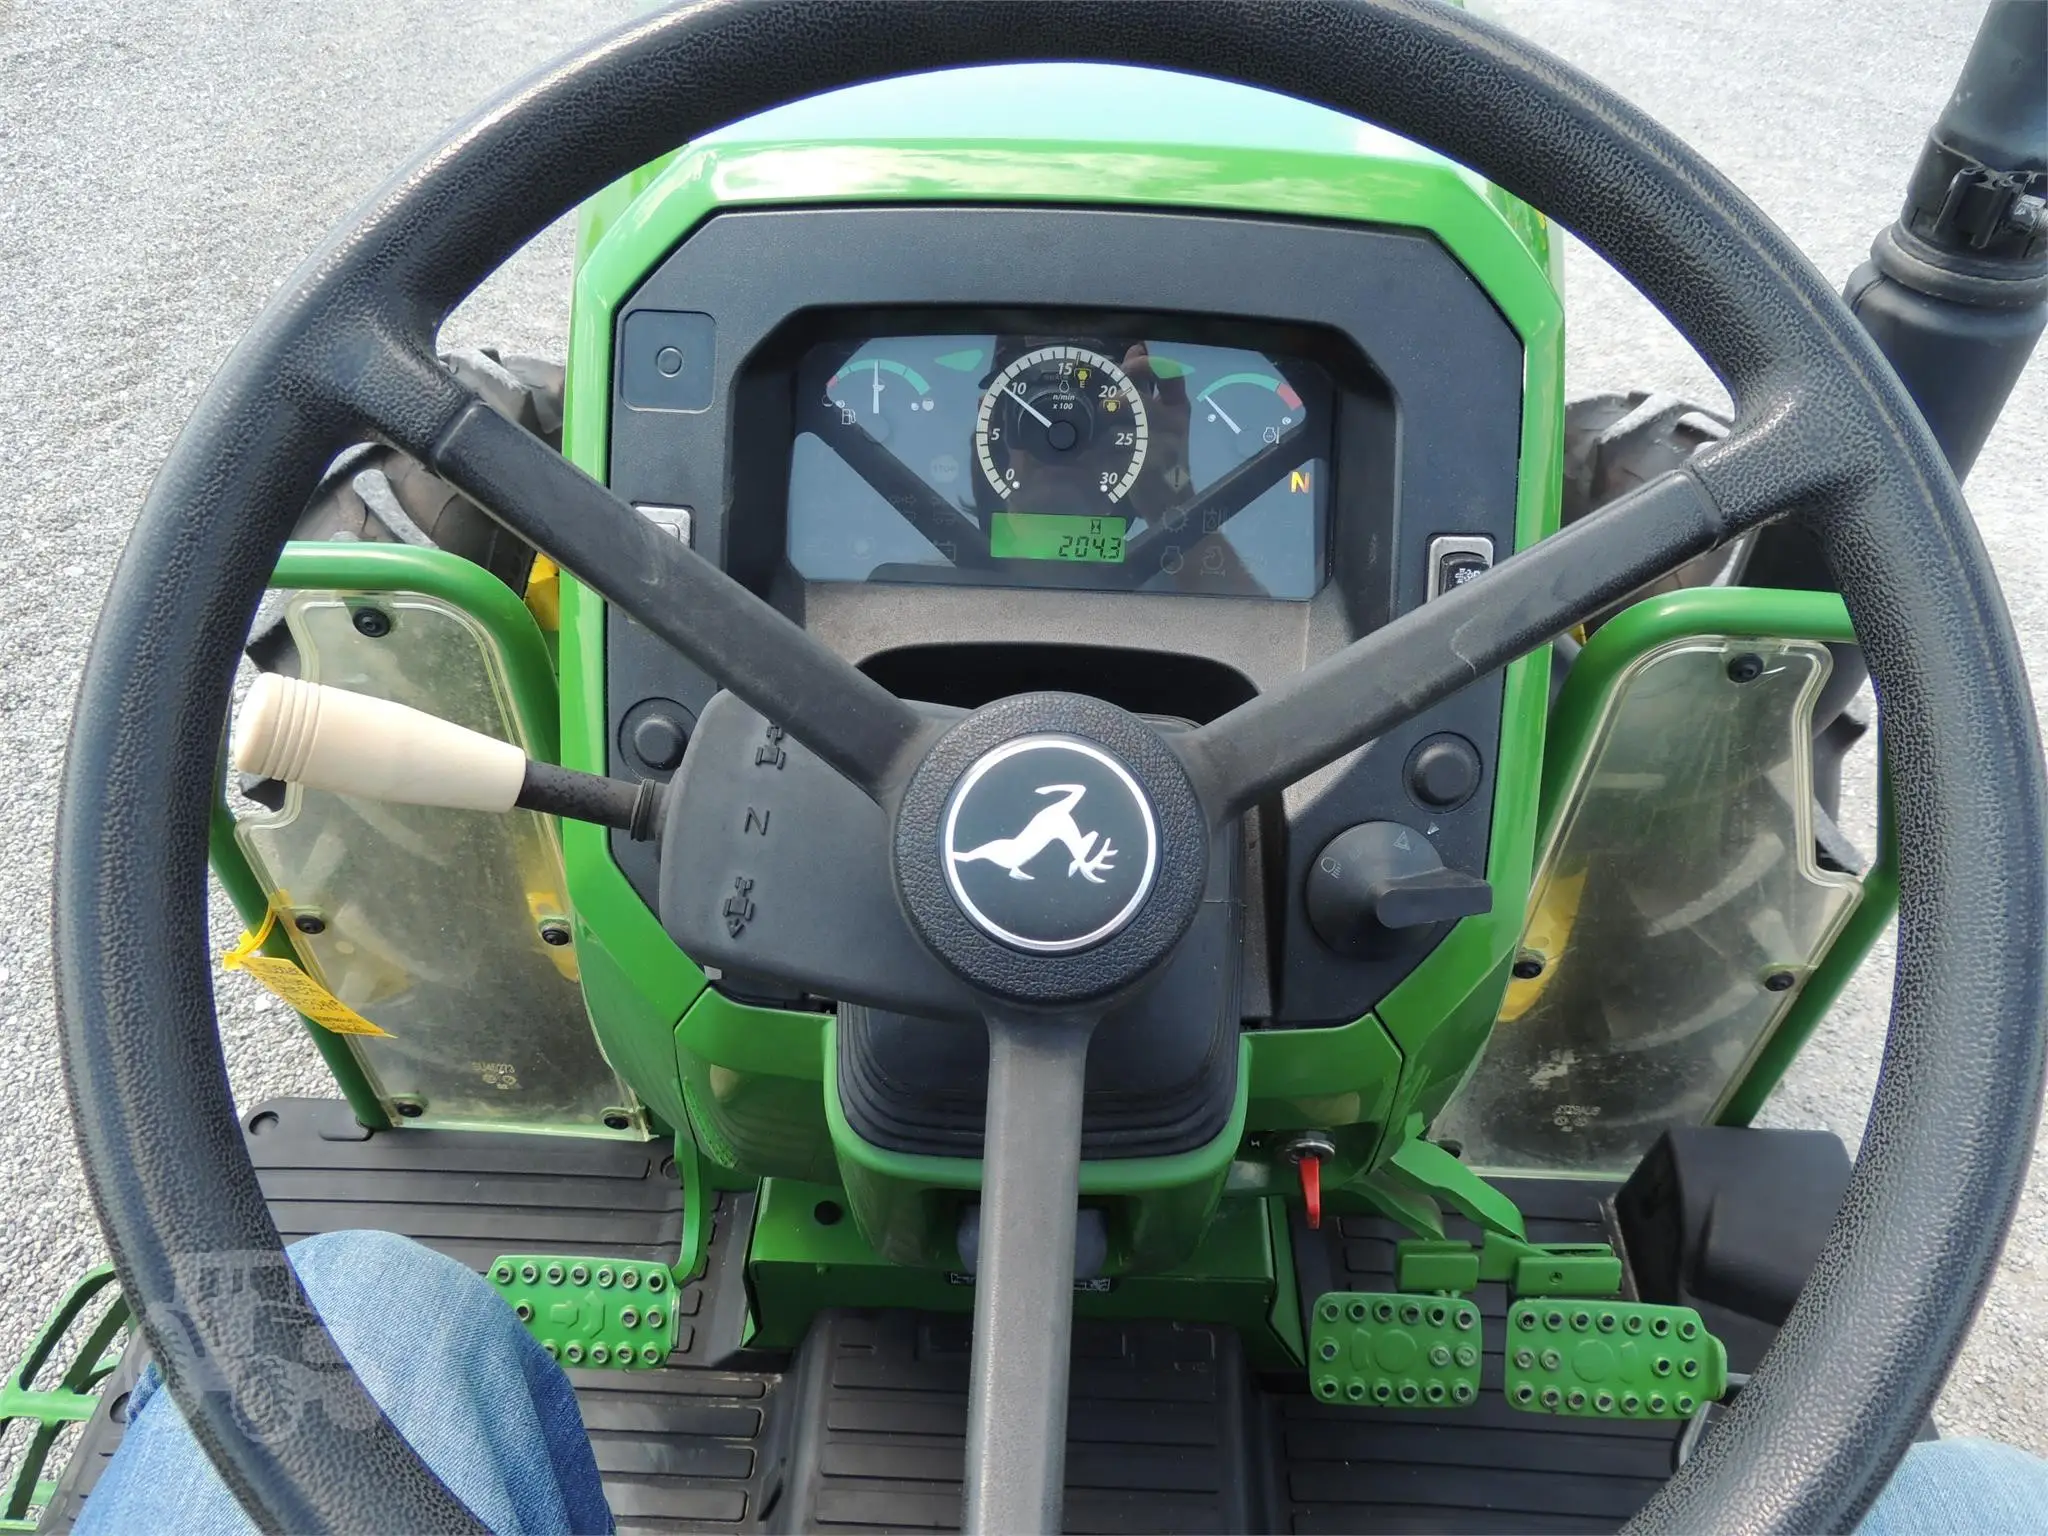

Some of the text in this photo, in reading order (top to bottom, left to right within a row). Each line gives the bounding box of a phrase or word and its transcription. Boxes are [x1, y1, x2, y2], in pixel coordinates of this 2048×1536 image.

[1058, 362, 1073, 375] 15
[1011, 382, 1027, 395] 10
[1099, 385, 1117, 398] 20
[991, 428, 1000, 441] 5
[1115, 433, 1133, 446] 25
[1005, 468, 1015, 481] 0
[1100, 472, 1118, 485] 30
[1291, 472, 1310, 494] N
[1058, 536, 1121, 559] 204.3
[744, 807, 770, 836] N
